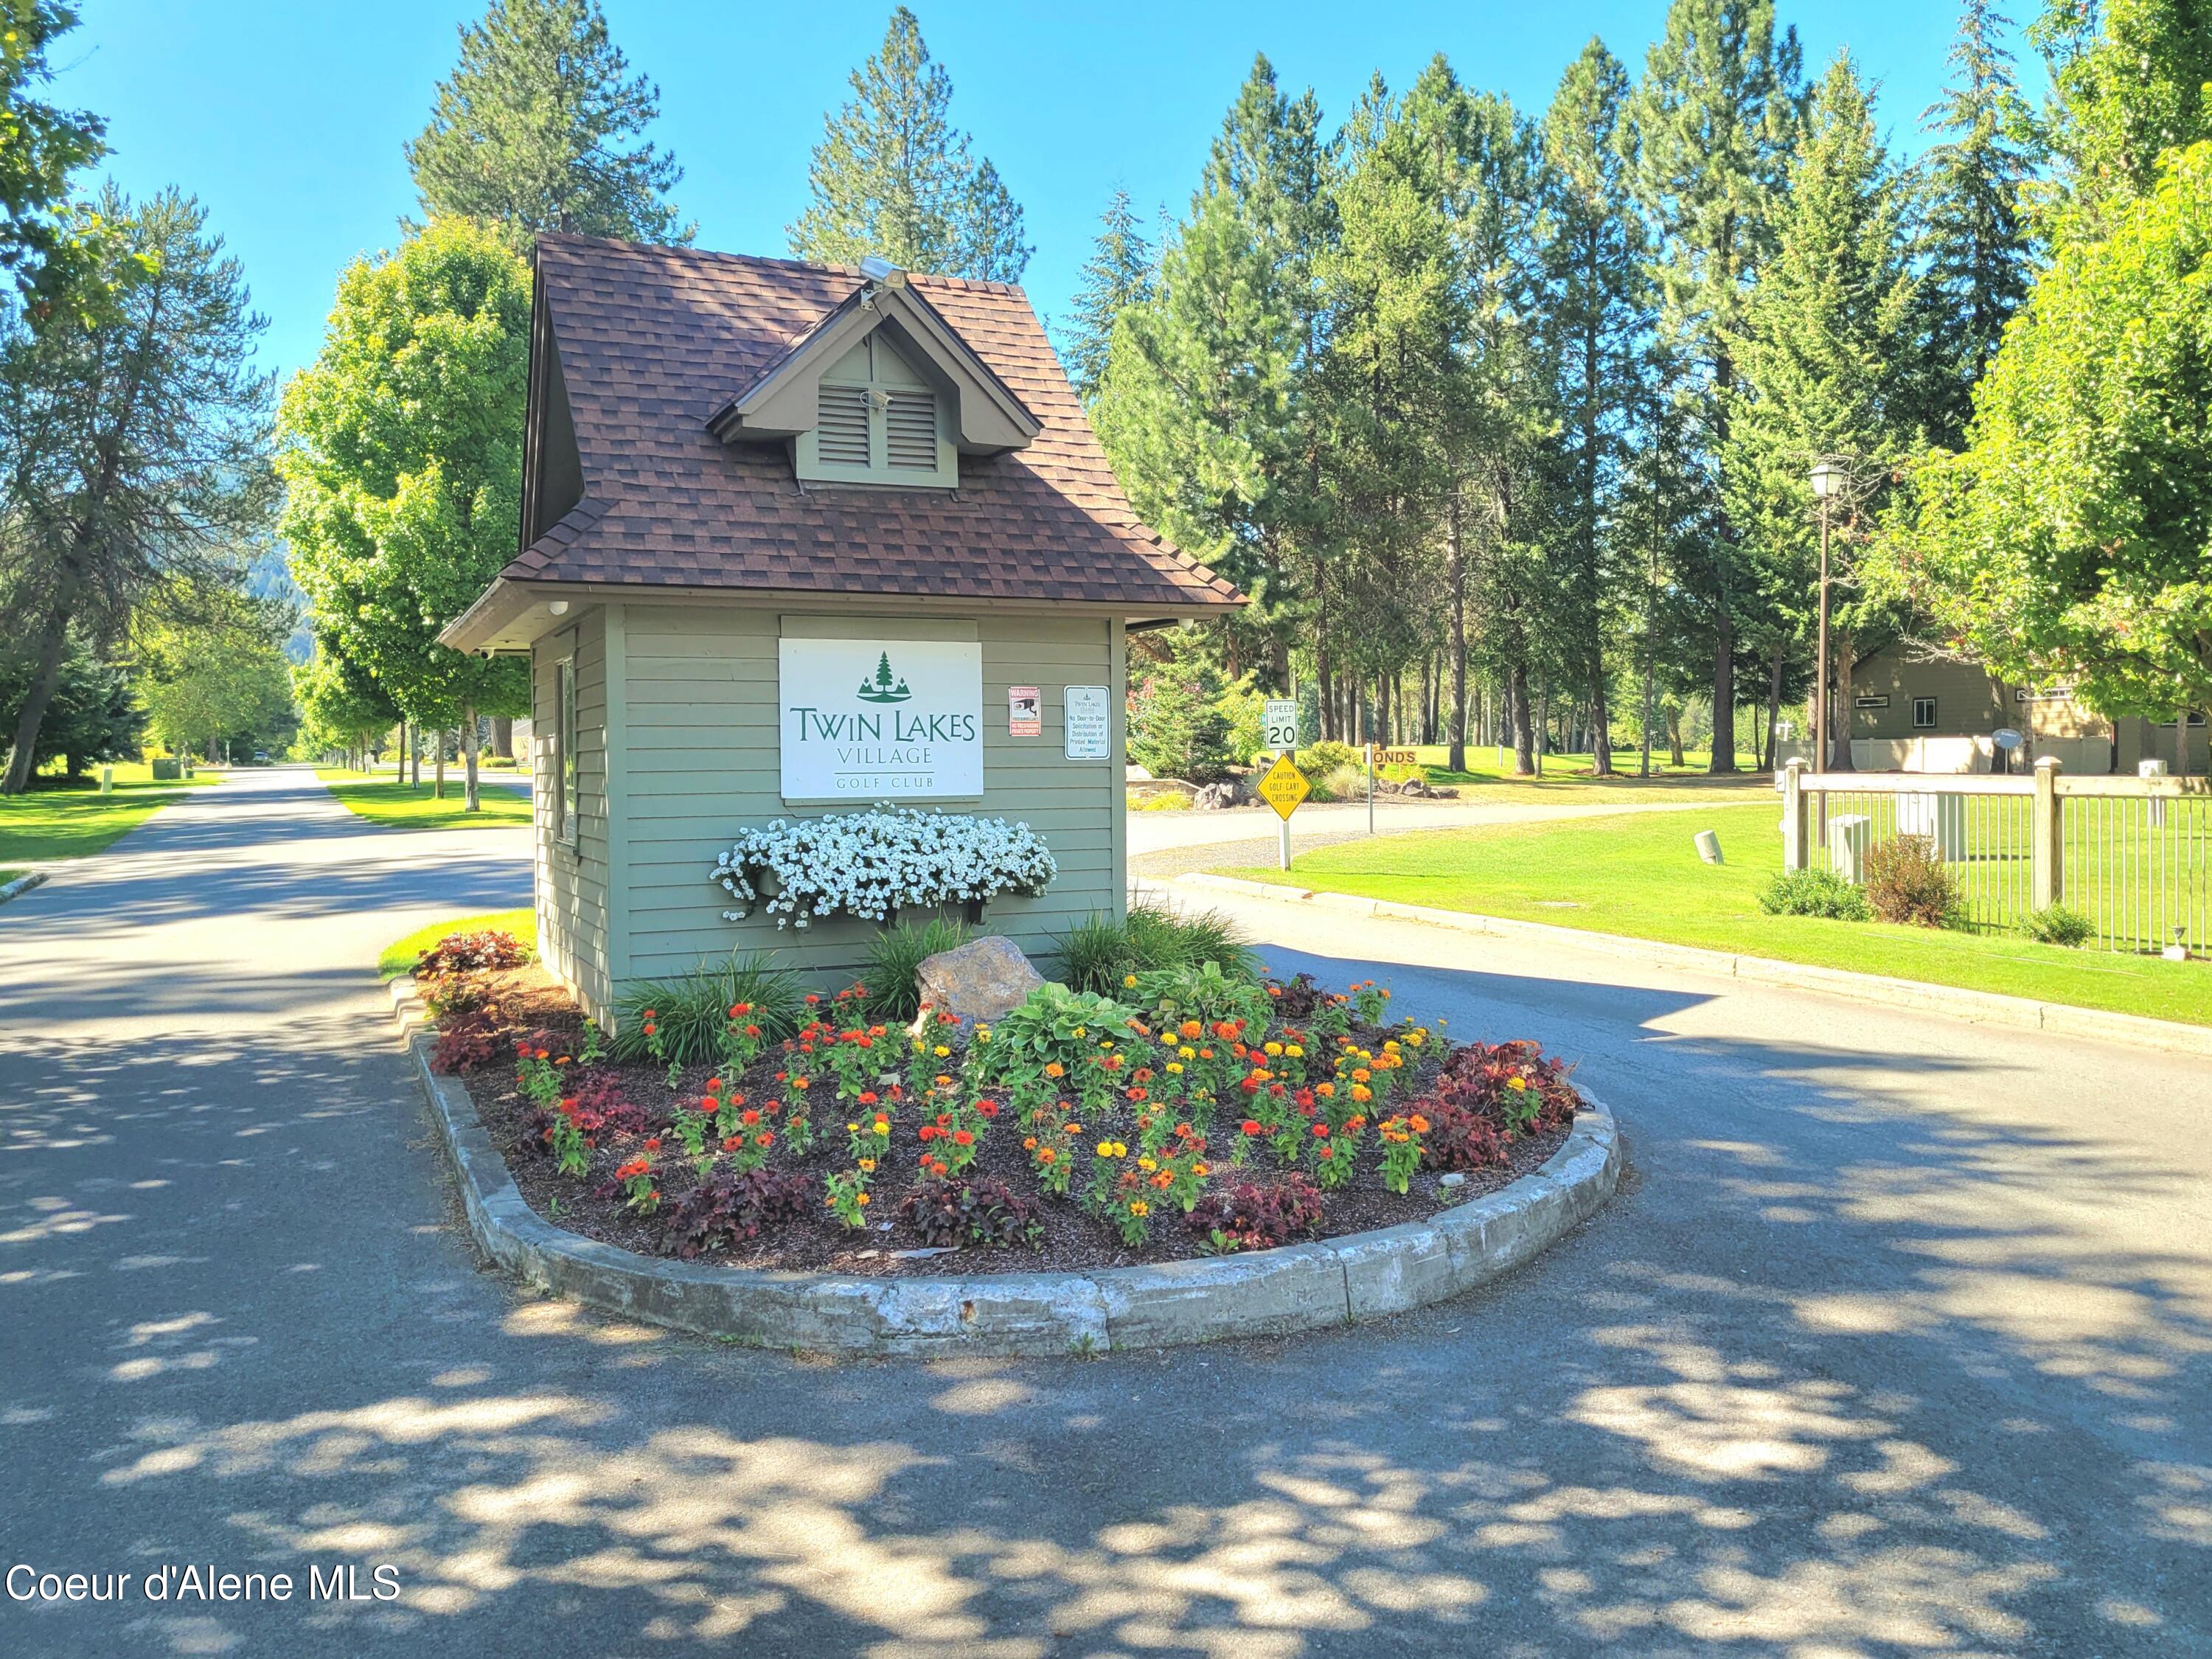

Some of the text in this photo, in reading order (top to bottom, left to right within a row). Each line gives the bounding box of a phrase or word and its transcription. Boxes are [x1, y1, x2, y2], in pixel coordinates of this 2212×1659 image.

[790, 707, 975, 742] TWIN LAKES
[1269, 726, 1295, 744] 20
[837, 748, 933, 764] VILLAGE
[1273, 771, 1295, 780] CAUTION
[837, 777, 933, 789] GOLF CLUB
[1269, 782, 1299, 791] GOLF CART
[1272, 793, 1298, 802] CROSSING
